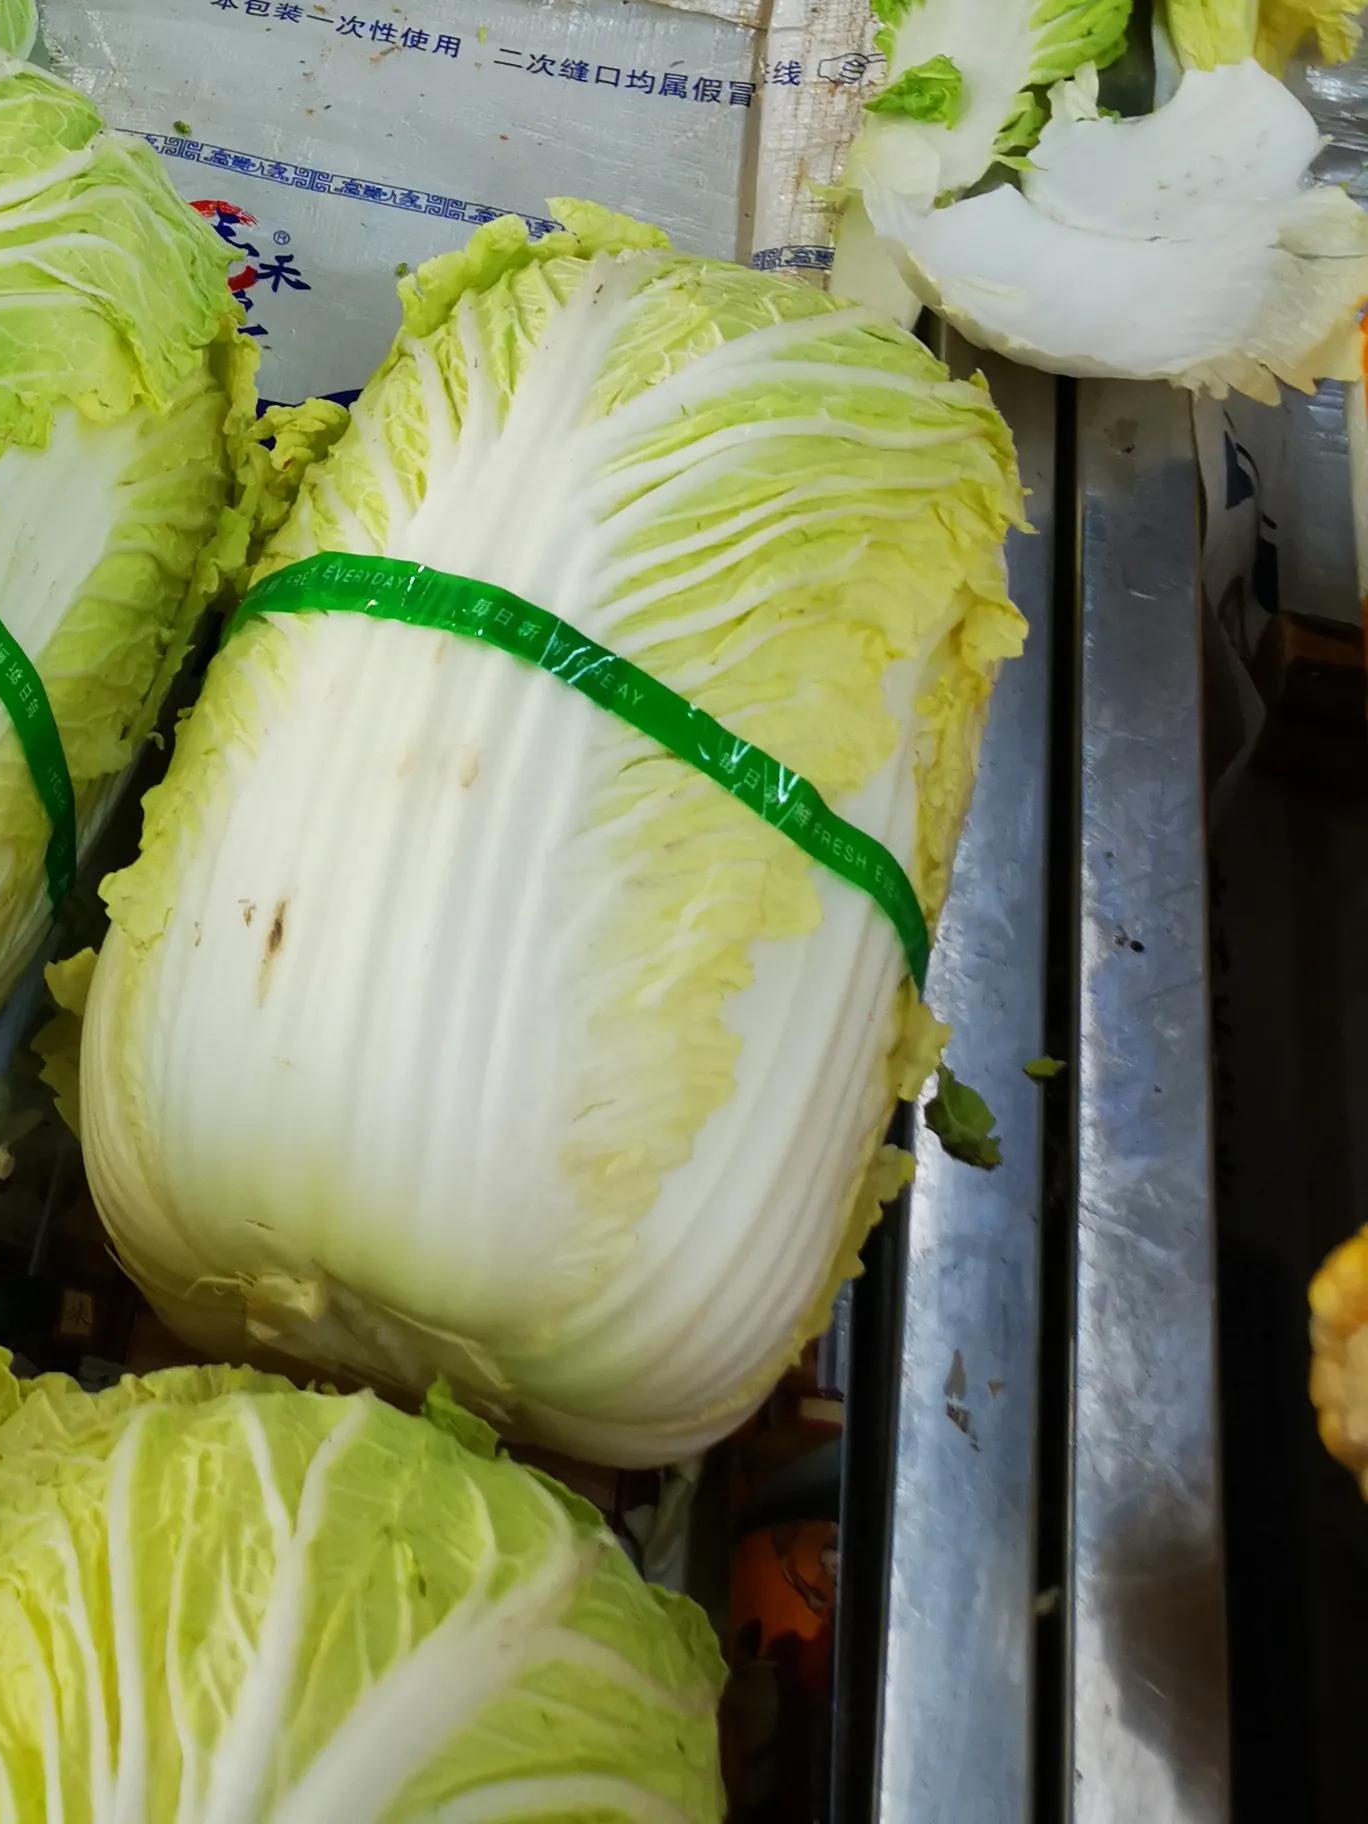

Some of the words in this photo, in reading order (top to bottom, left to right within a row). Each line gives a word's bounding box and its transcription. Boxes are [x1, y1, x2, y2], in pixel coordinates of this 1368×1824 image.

[493, 47, 757, 108] 二次缝口均属假冒
[811, 820, 868, 870] FRESH
